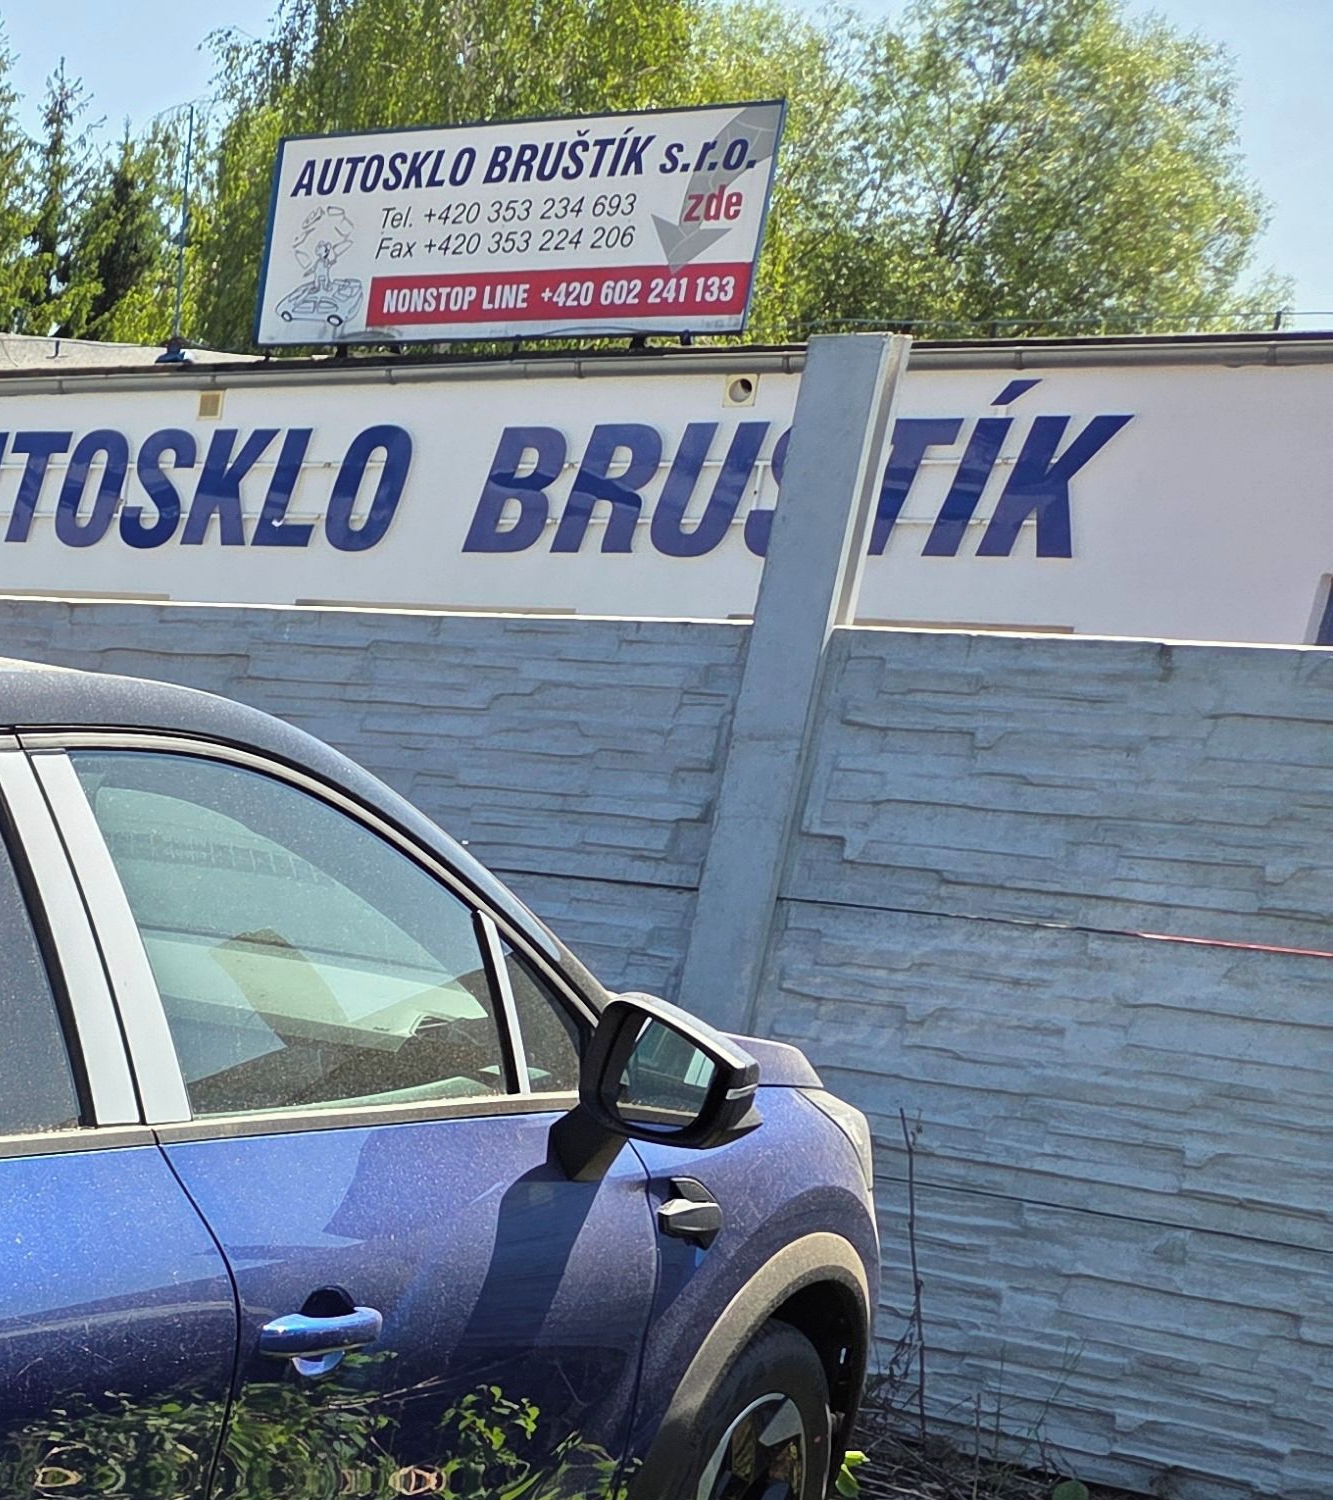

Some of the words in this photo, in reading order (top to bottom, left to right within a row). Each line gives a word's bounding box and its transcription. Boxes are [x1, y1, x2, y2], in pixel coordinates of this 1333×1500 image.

[290, 146, 477, 198] AUTOSKLO
[483, 126, 657, 184] BRUŠTÍK
[659, 138, 758, 174] s.r.o.
[381, 205, 414, 230] Tel.
[423, 201, 482, 227] +420
[487, 198, 533, 224] 353
[539, 195, 586, 220] 234
[592, 192, 638, 218] 693
[683, 184, 744, 223] zde
[374, 235, 417, 261] Fax
[423, 232, 482, 257] +420
[487, 229, 533, 255] 353
[538, 227, 585, 252] 224
[589, 224, 636, 249] 206
[382, 285, 477, 315] NONSTOP
[481, 283, 530, 311] LINE
[541, 281, 595, 308] +420
[599, 278, 643, 306] 602
[647, 276, 688, 304] 241
[695, 275, 736, 303] 133
